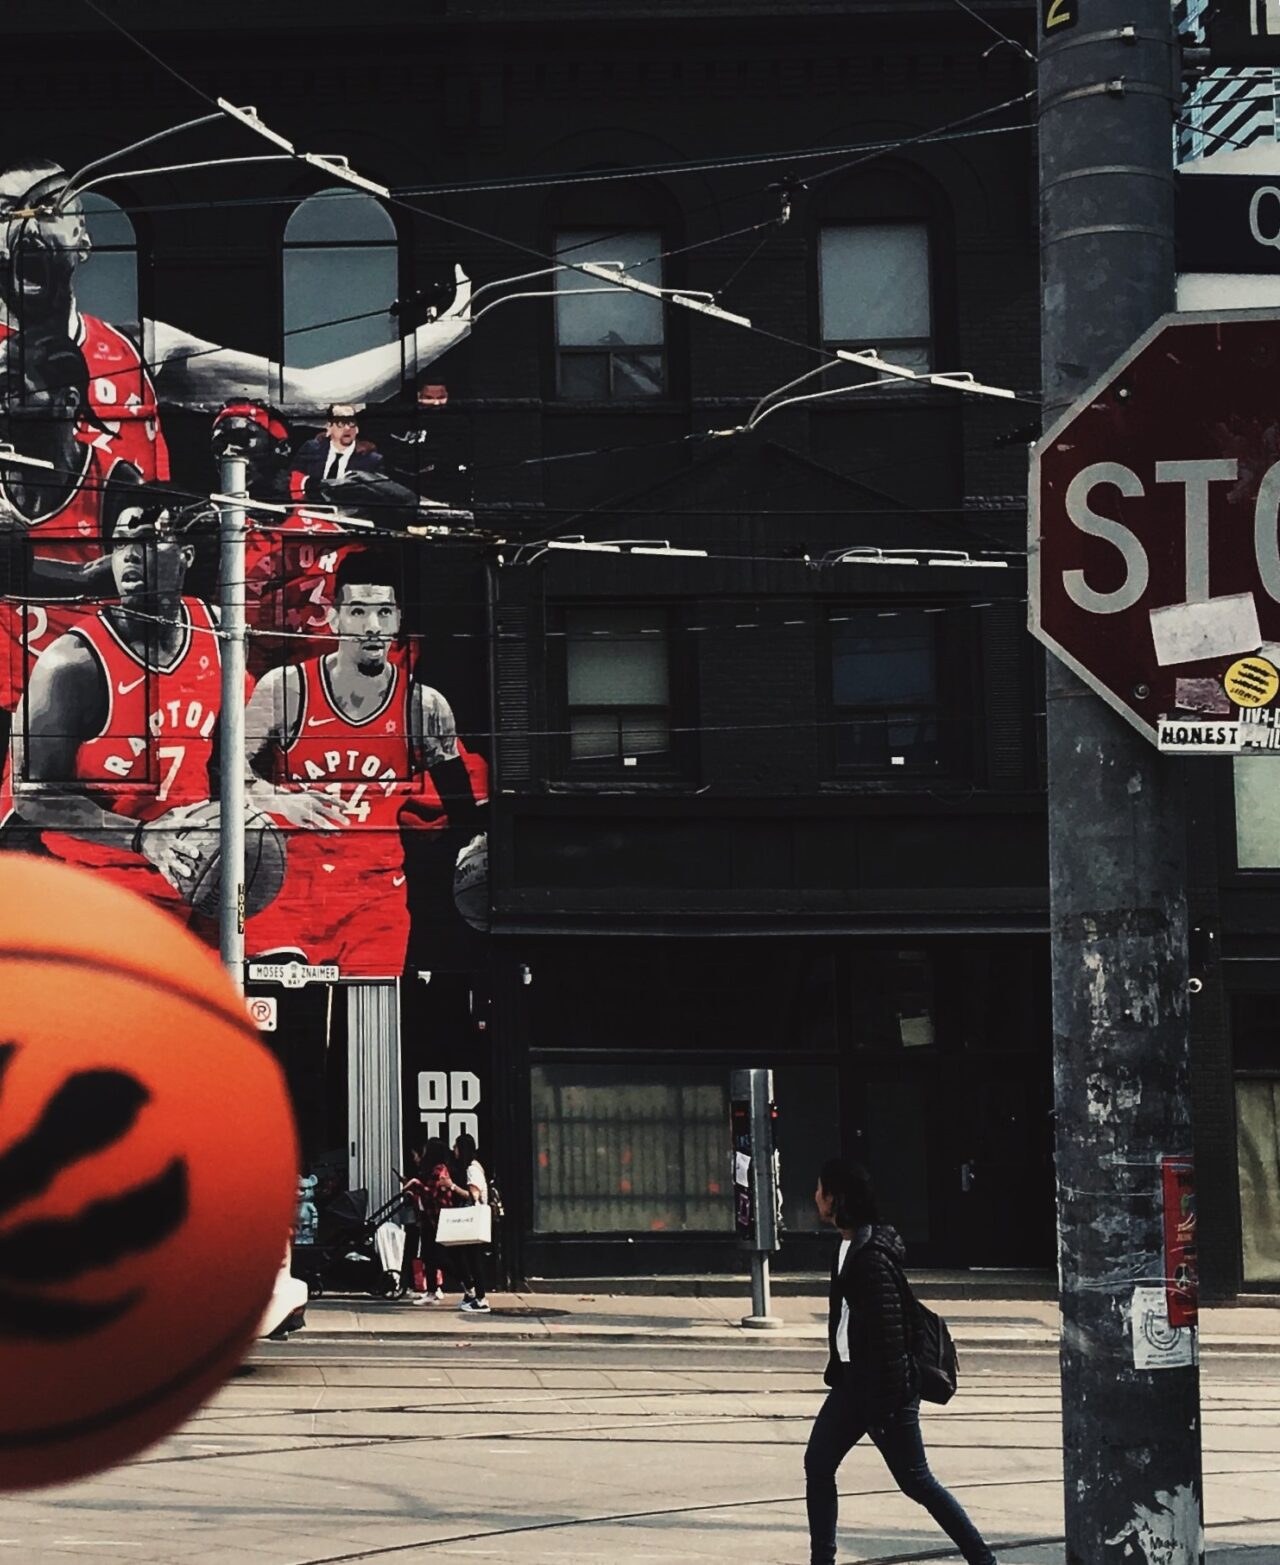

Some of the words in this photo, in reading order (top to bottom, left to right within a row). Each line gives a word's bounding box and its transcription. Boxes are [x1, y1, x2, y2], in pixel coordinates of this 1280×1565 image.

[1161, 726, 1239, 745] HONEST
[155, 746, 186, 801] 7
[256, 966, 284, 979] MOSES
[301, 967, 336, 979] ZNAIMER
[417, 1071, 481, 1110] OD
